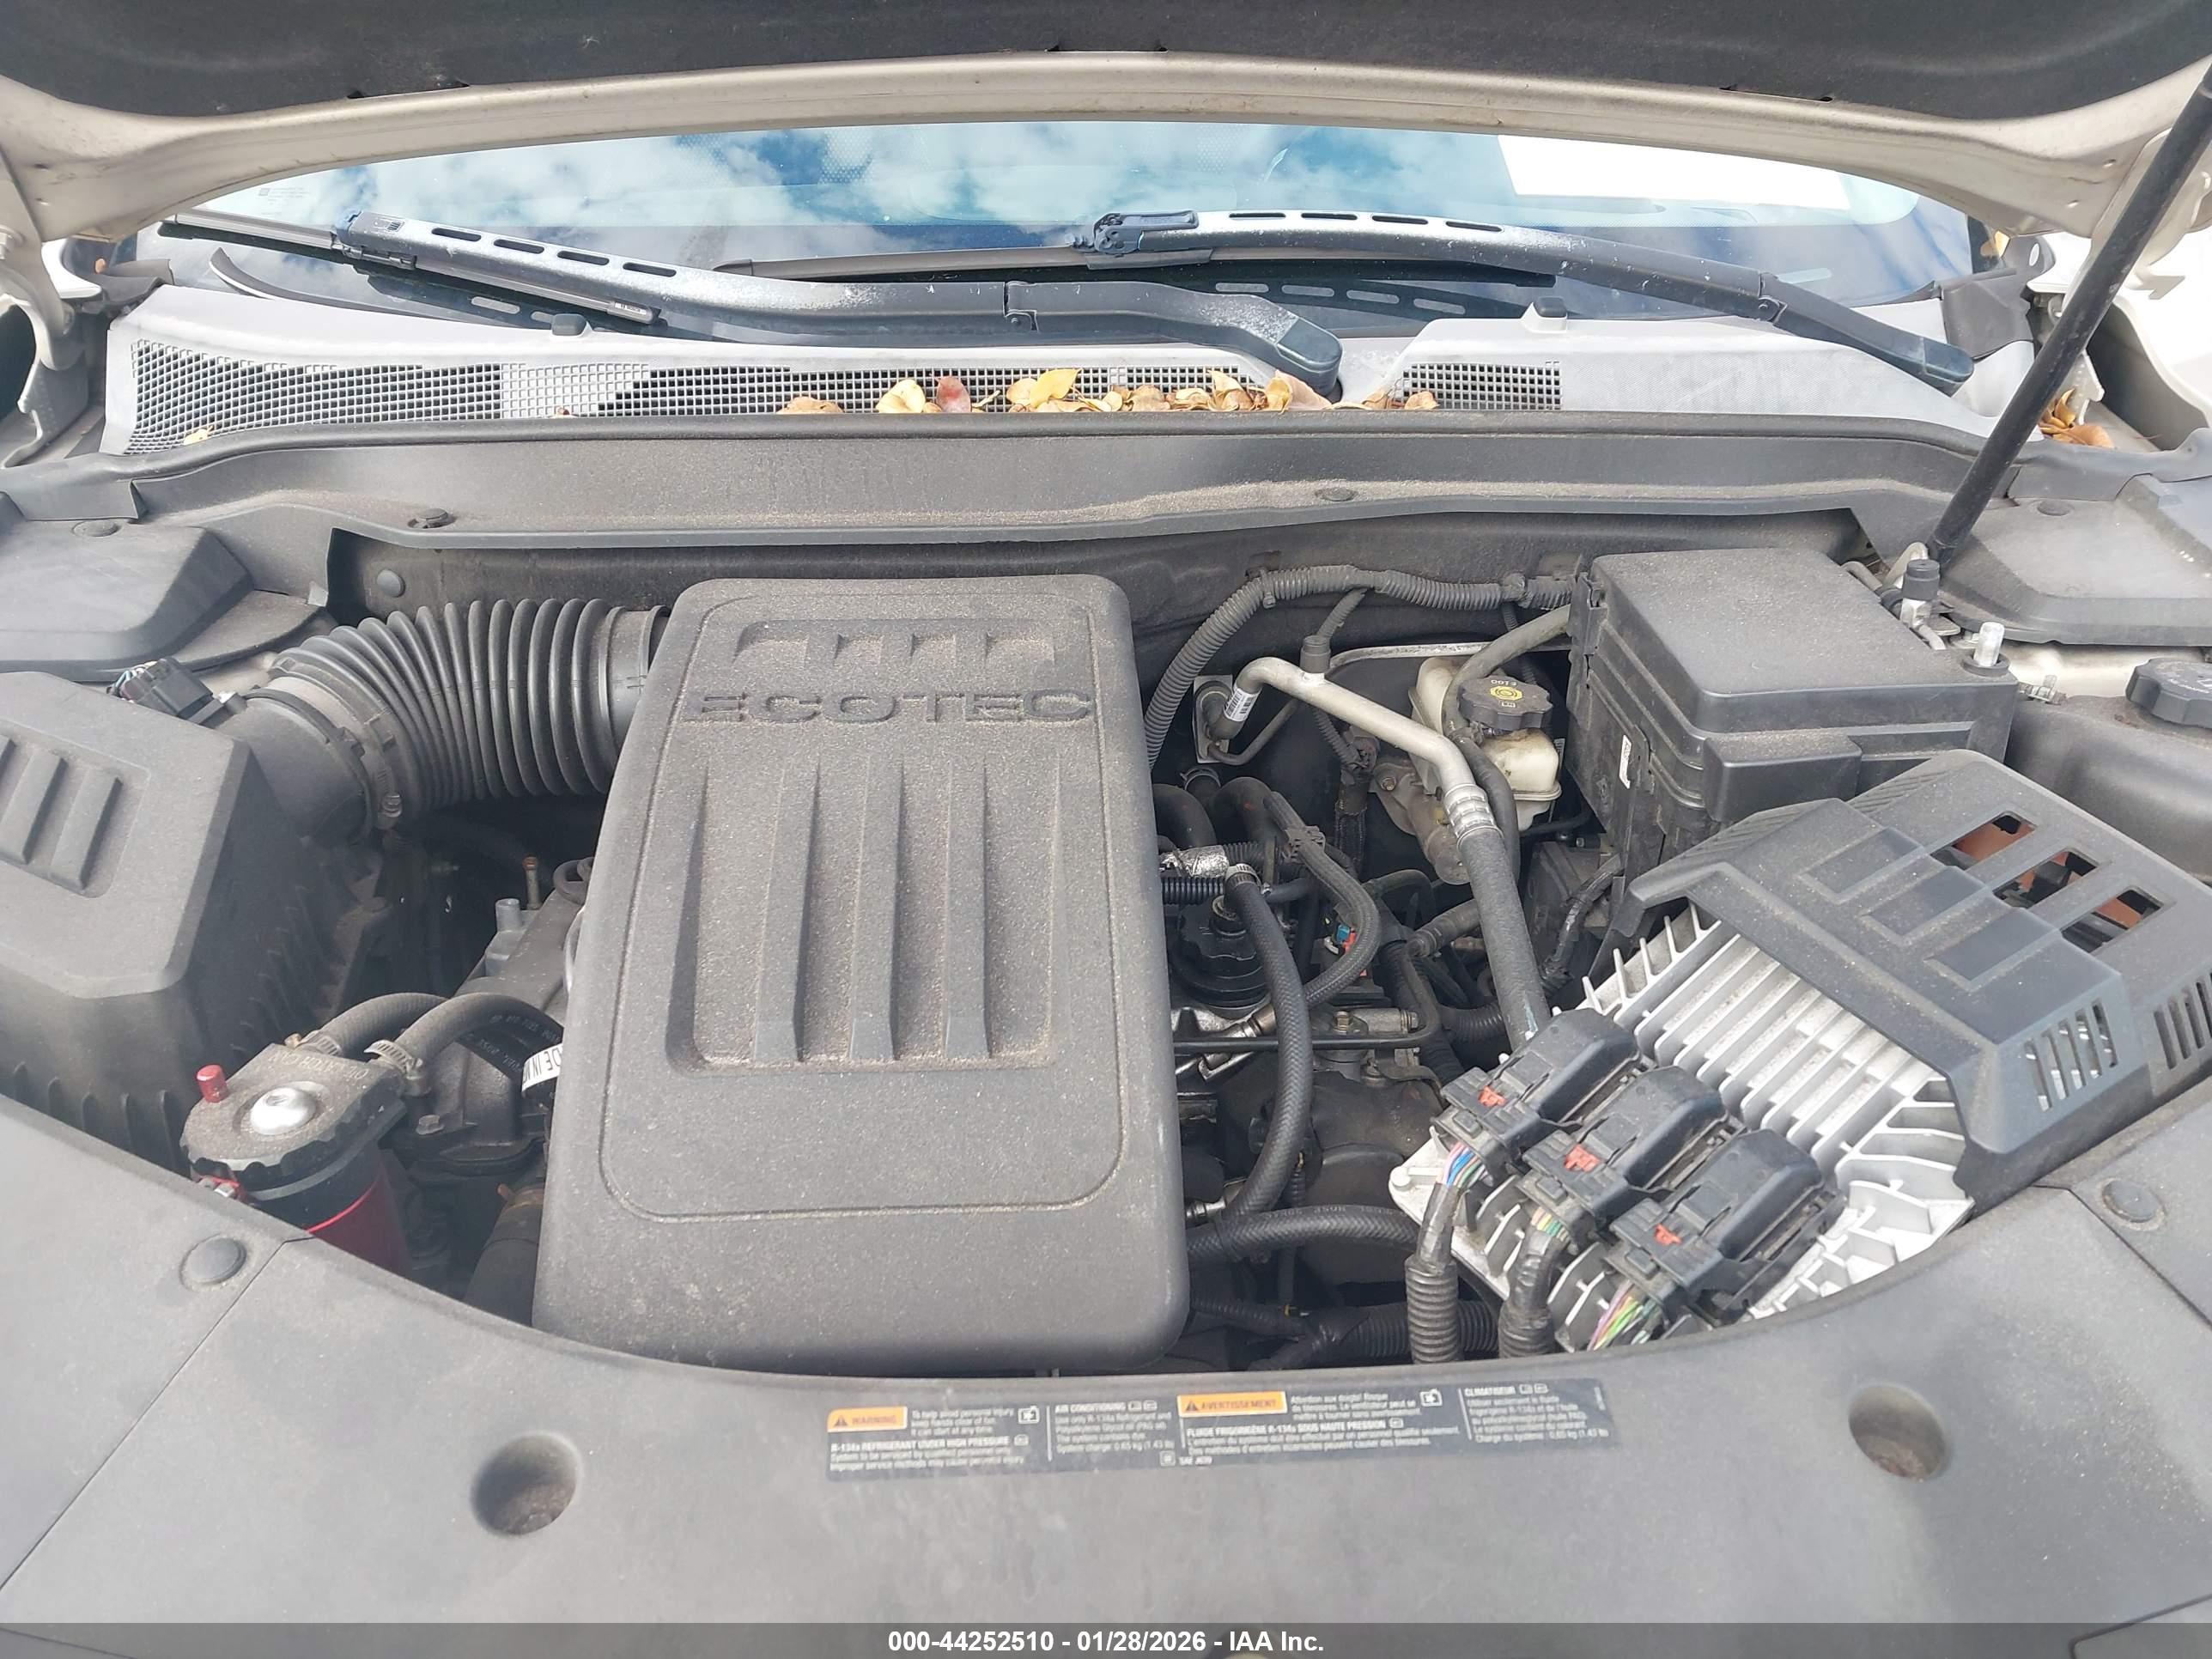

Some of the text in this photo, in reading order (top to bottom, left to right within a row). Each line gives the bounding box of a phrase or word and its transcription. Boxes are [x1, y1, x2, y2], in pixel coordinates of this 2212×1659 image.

[685, 690, 1096, 724] ECOTEC
[1070, 1401, 1126, 1413] CONDITIONING
[1201, 1399, 1277, 1410] AVERTISSEMENT
[852, 1415, 897, 1425] WARNING
